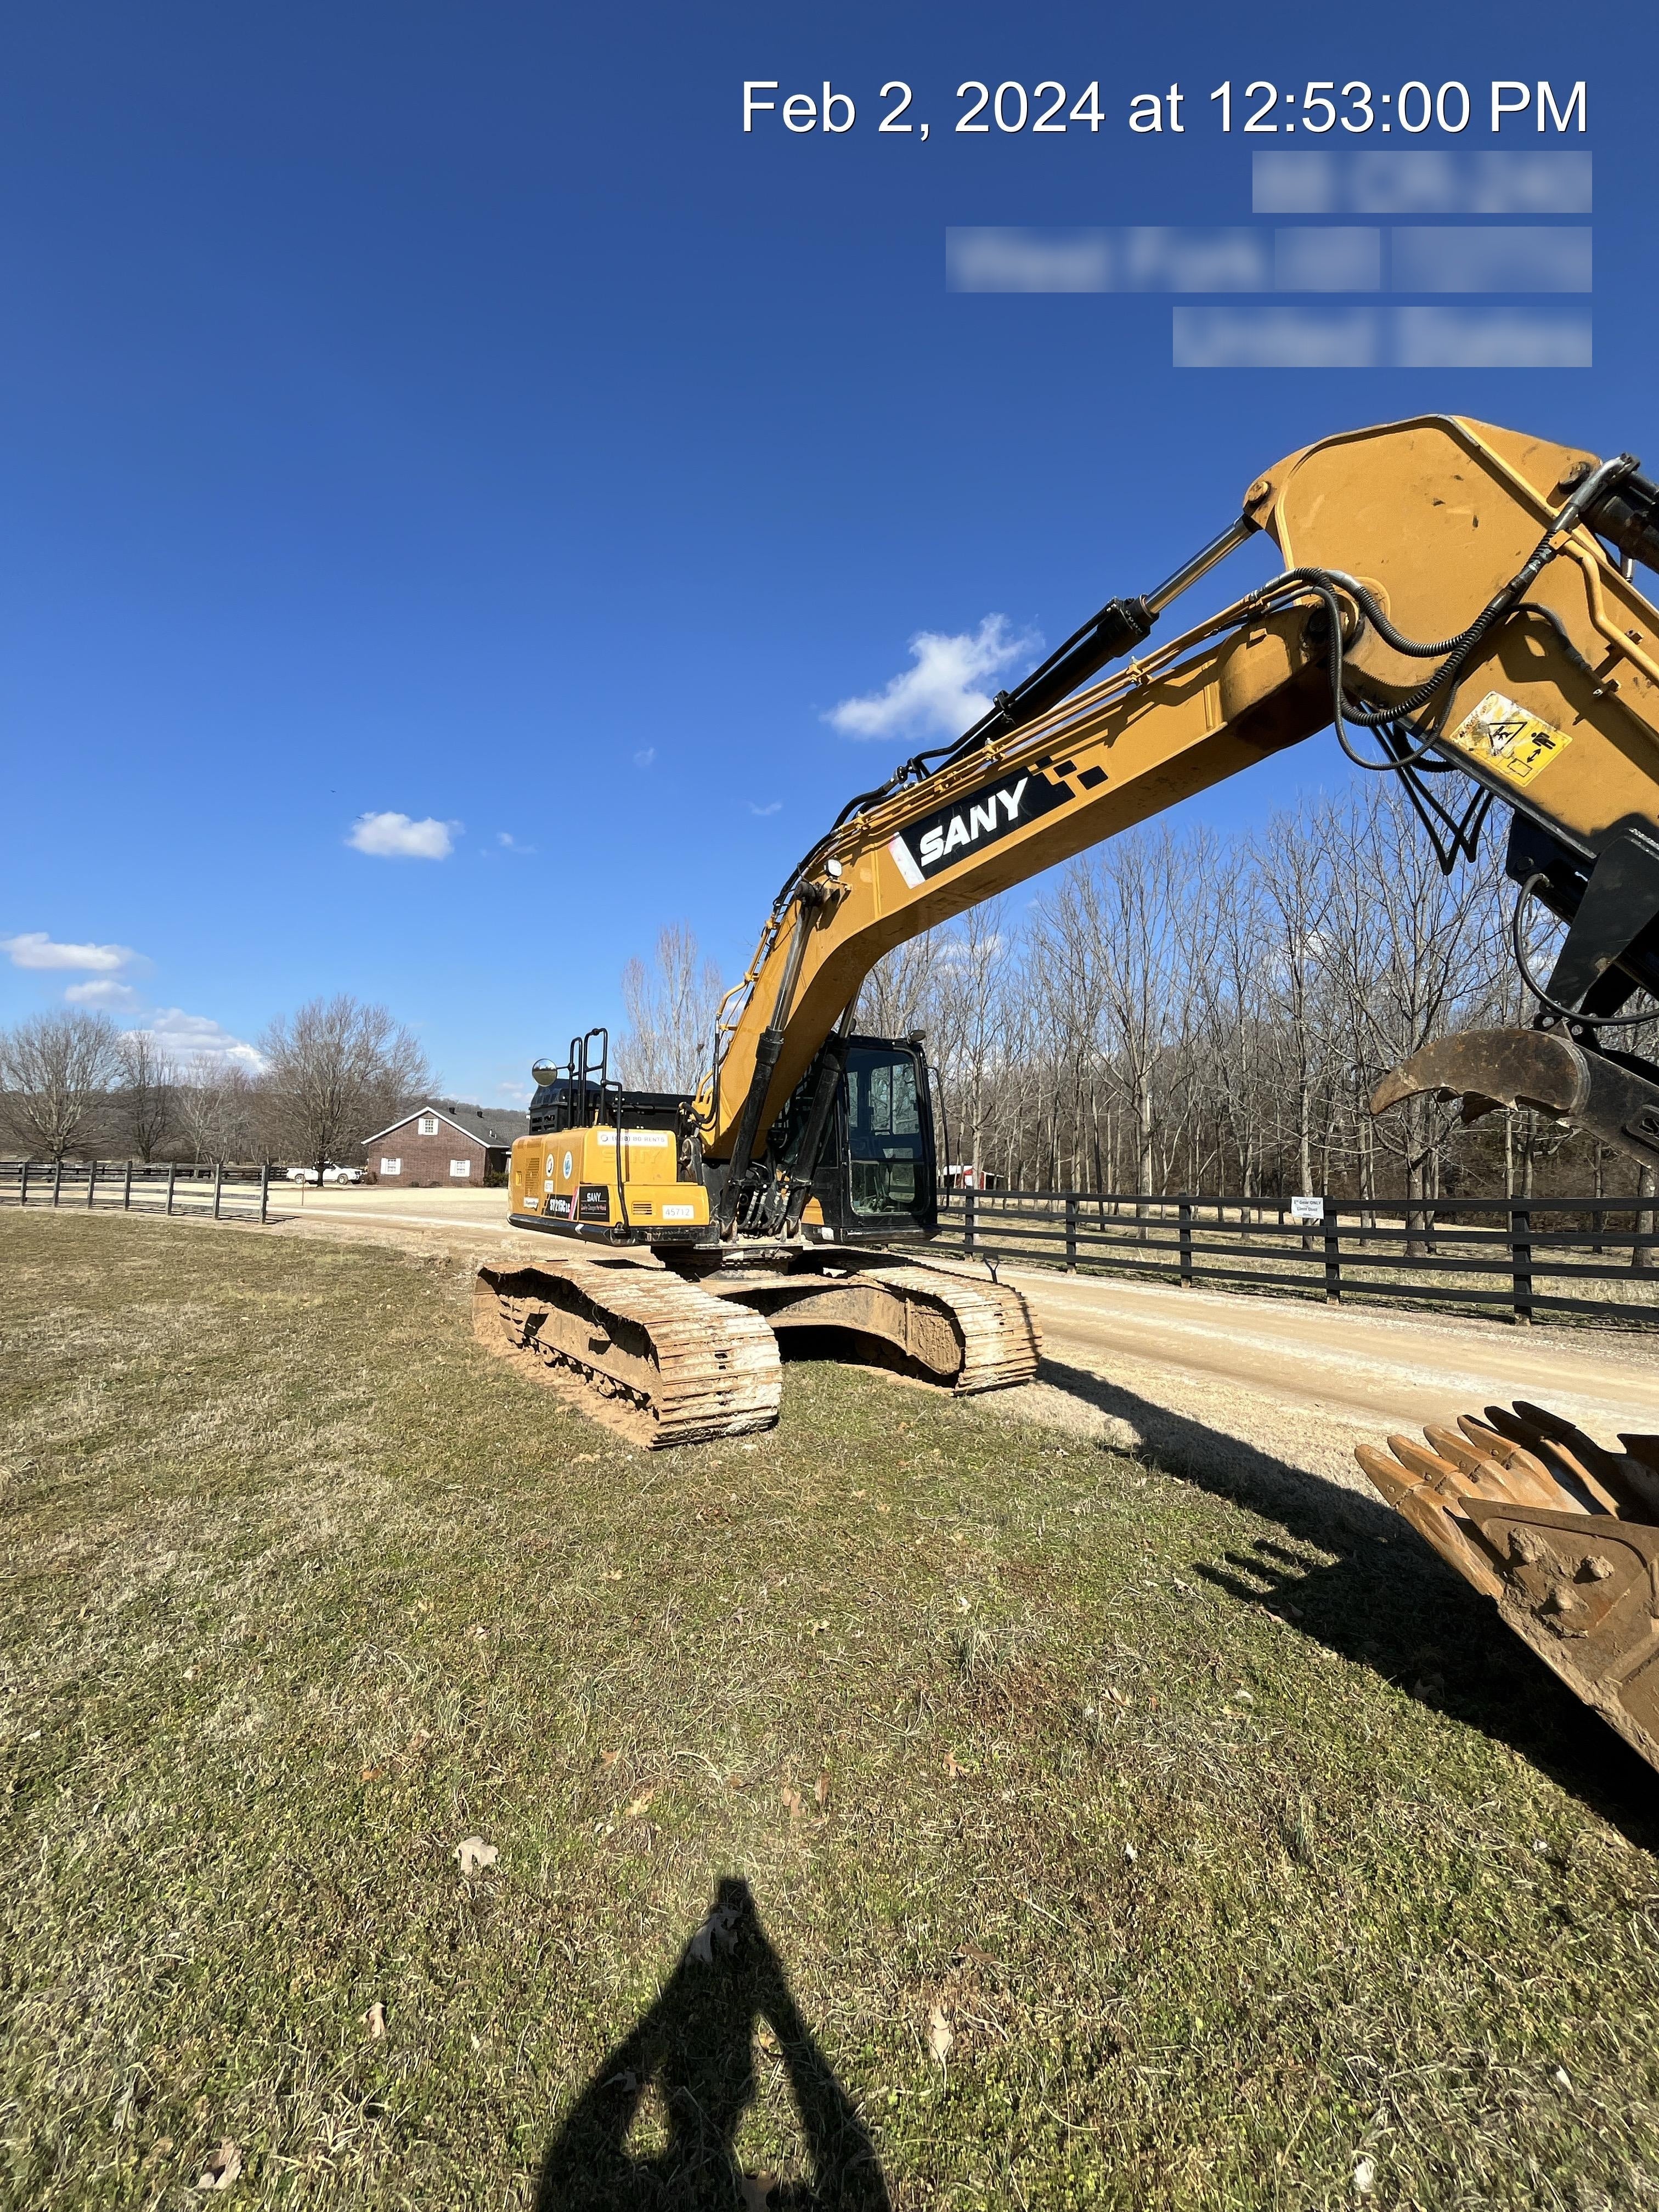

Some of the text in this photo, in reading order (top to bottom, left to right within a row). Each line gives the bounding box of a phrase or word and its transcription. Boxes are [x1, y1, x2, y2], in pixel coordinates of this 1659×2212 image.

[921, 777, 1029, 867] SANY
[587, 1192, 601, 1202] SANY
[665, 1208, 690, 1216] 45712
